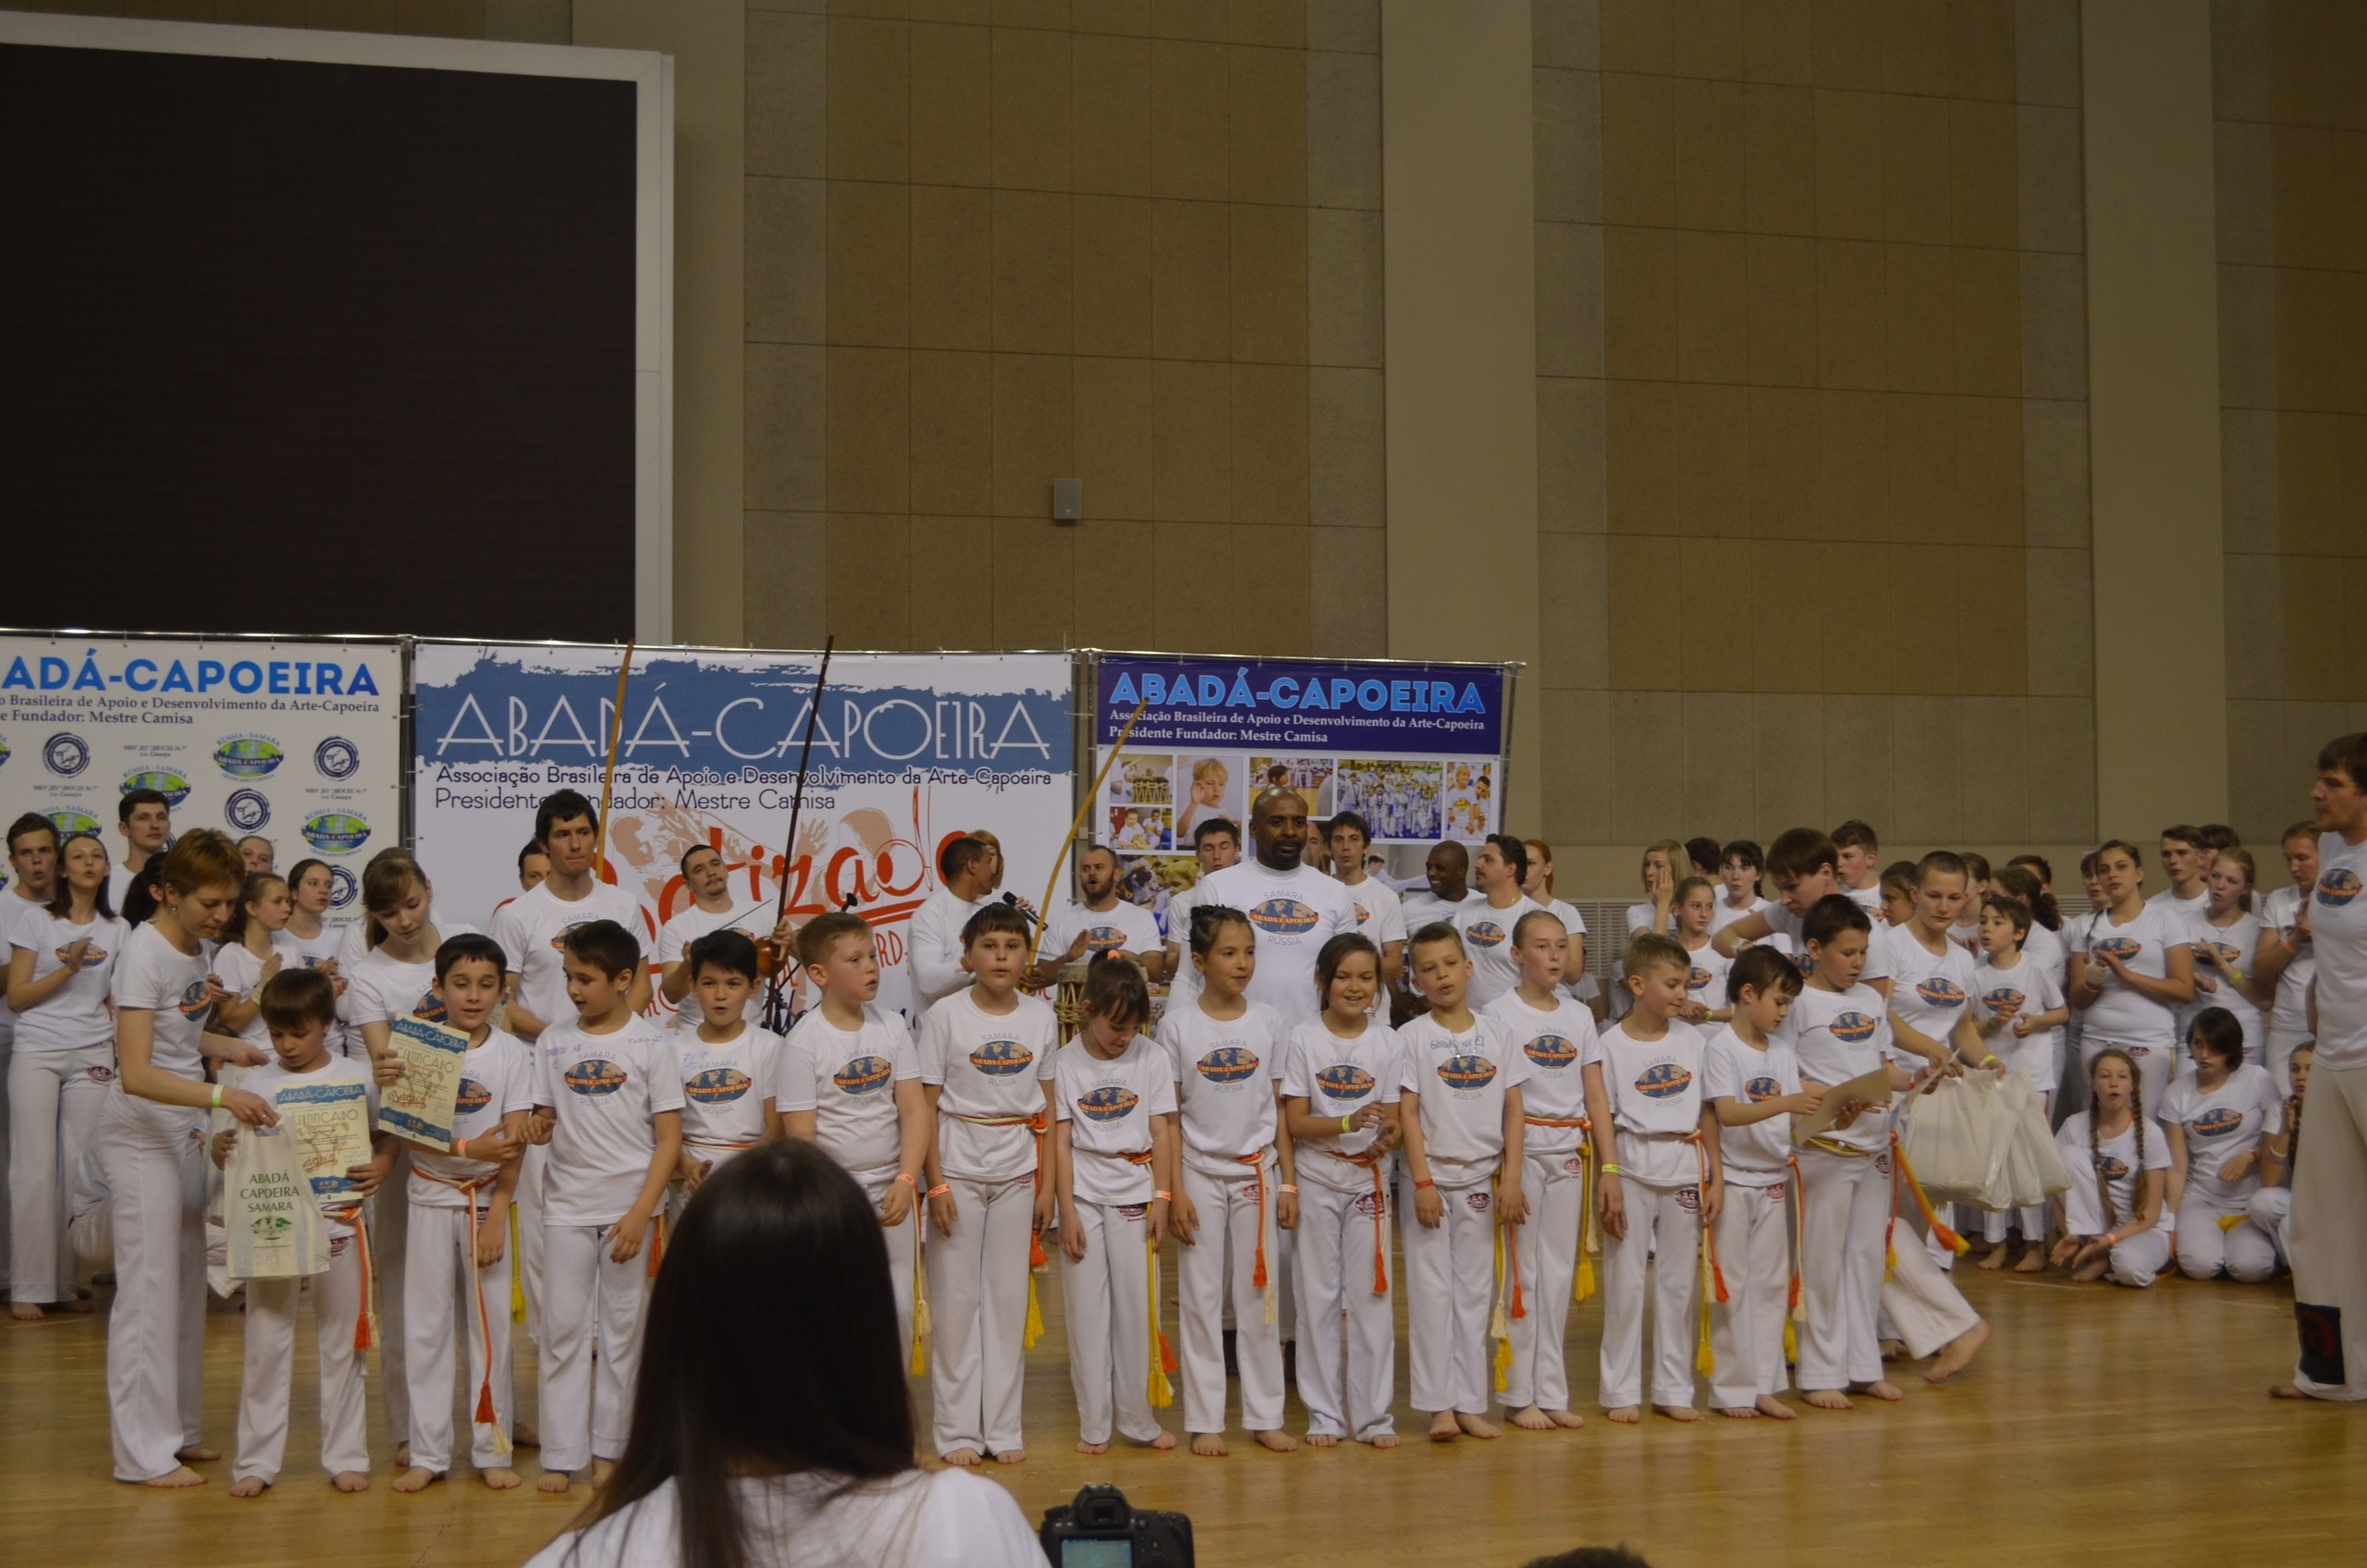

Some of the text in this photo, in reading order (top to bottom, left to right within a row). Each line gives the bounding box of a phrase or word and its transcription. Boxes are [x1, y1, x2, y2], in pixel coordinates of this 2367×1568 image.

[1, 648, 379, 695] ADÁ-CAPOEIRA
[1109, 667, 1486, 714] ABADÁ-CAPOEIRA
[10, 694, 73, 706] Brasileira
[78, 695, 92, 707] de
[97, 696, 137, 710] Apoio
[153, 697, 267, 710] Desenvolvimento
[271, 699, 286, 710] da
[290, 700, 379, 715] Arte-Capoeira
[12, 709, 85, 722] Fundador:
[90, 711, 138, 723] Mestre
[141, 712, 193, 725] Camisa
[436, 681, 1050, 760] ABADÁ-CAPOEIRA
[1174, 711, 1227, 723] Brasileira
[1231, 712, 1244, 724] de
[1246, 713, 1281, 727] Apoio
[1293, 715, 1390, 728] Desenvolvimento
[1392, 717, 1405, 728] da
[1409, 718, 1484, 732] Arte-Capoeira
[1110, 726, 1328, 742] Prsidente Fundador: Mestre Camisa
[436, 765, 1051, 791] Associação Brasilera de Apoio e Desenvolvimento da Arte-Capoeira
[435, 787, 548, 810] President
[675, 789, 751, 810] Mestre
[1263, 890, 1304, 901] SAMARA
[1268, 935, 1302, 946] RÚSSIA
[982, 1033, 1020, 1042] SAMARA
[1209, 1039, 1247, 1049] SAMARA
[461, 1069, 480, 1080] ARA
[1089, 1078, 1127, 1089] SAMARA
[250, 1169, 290, 1183] ABADÁ
[240, 1186, 300, 1200] CAPOEIRA
[248, 1201, 293, 1213] SAMARA
